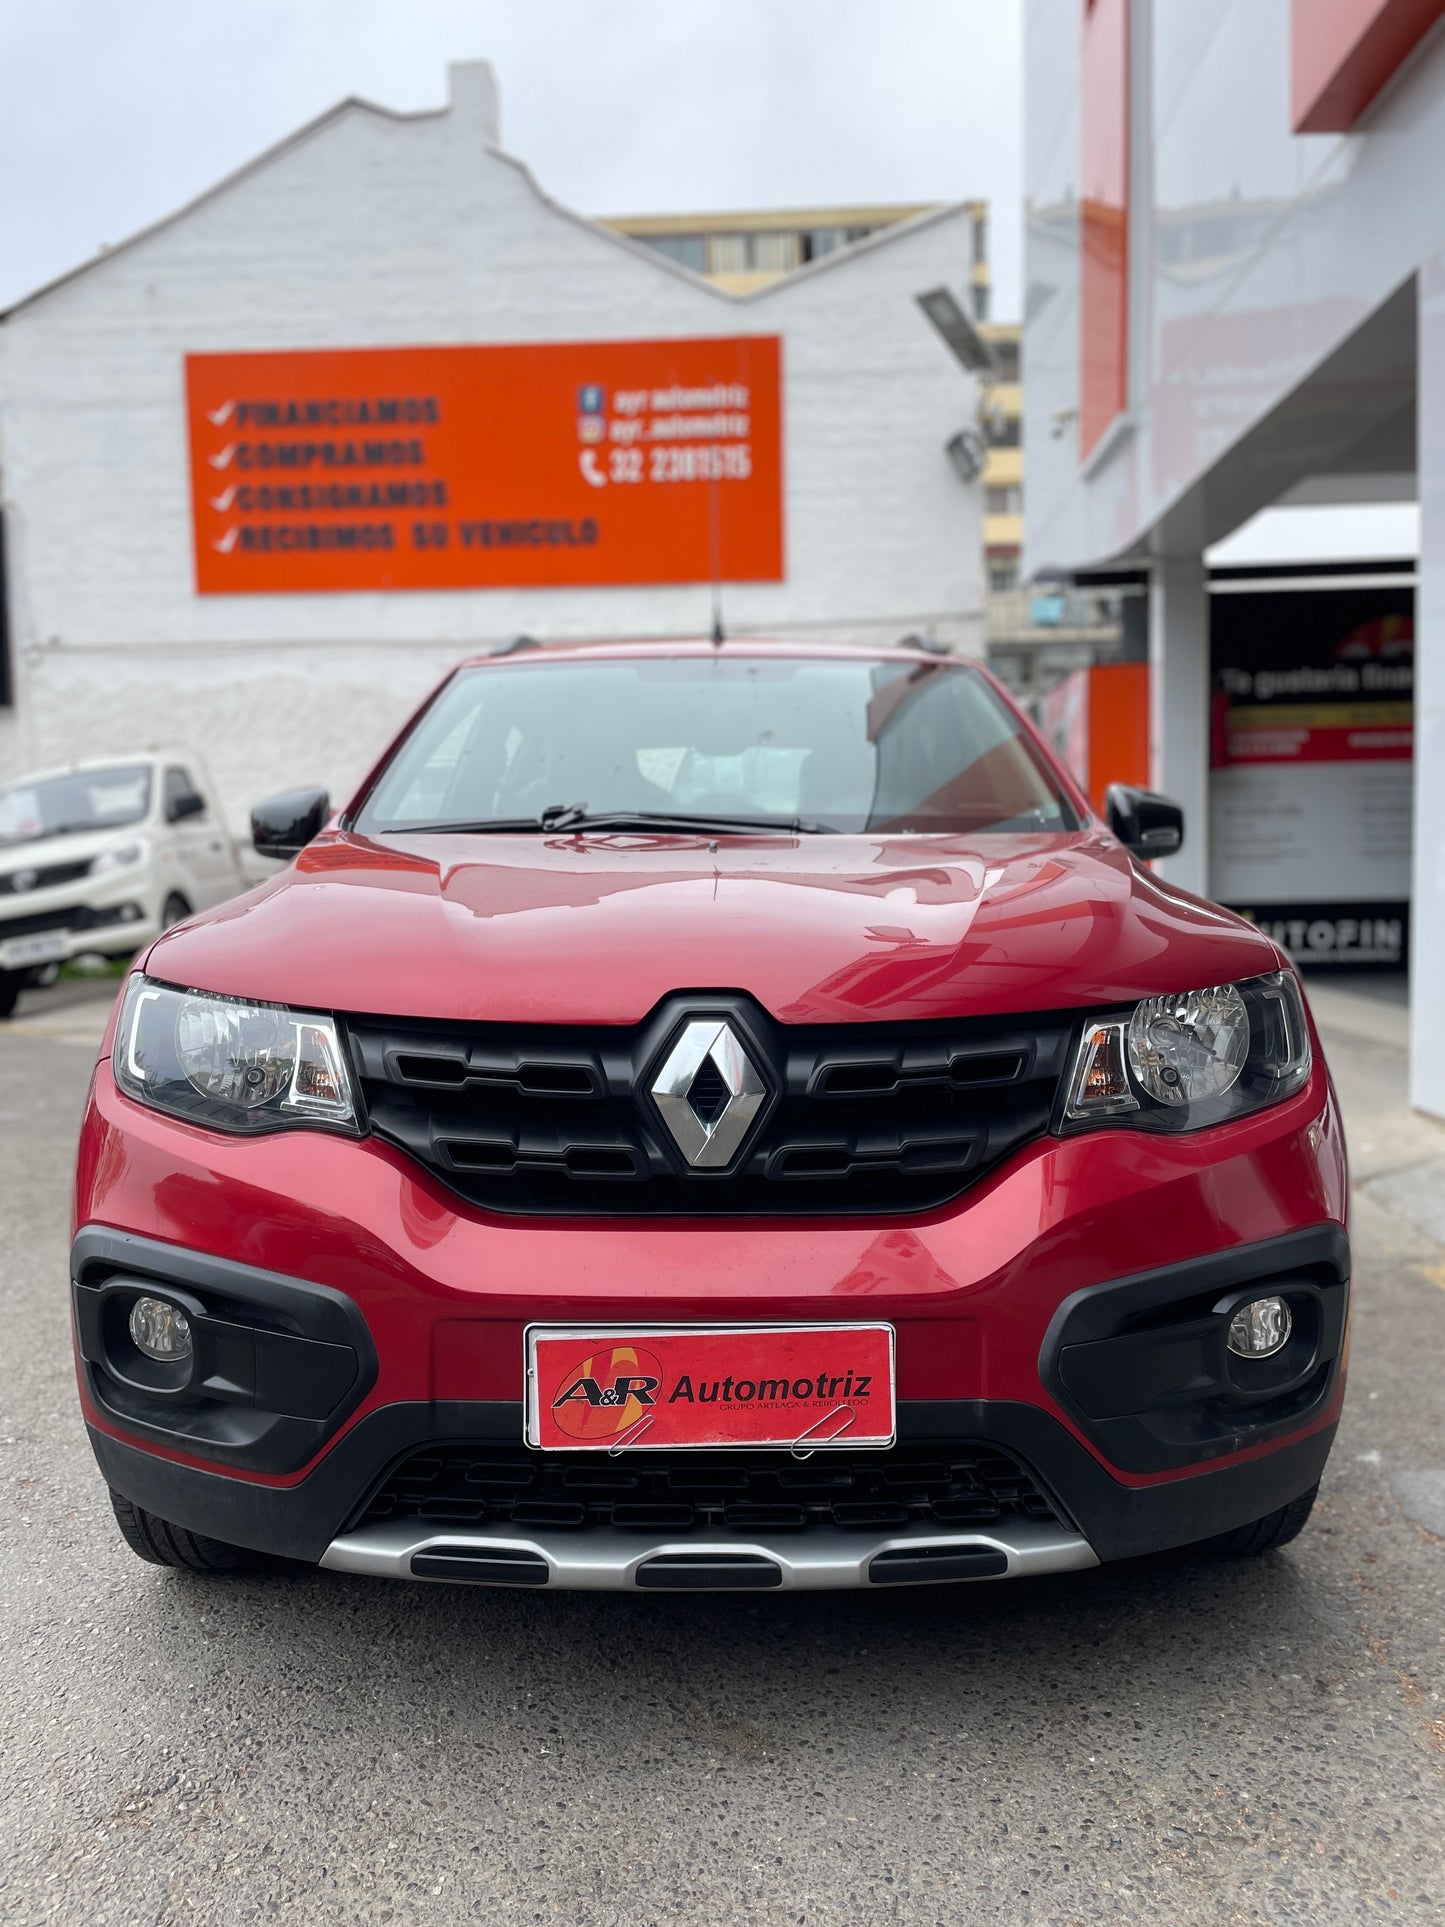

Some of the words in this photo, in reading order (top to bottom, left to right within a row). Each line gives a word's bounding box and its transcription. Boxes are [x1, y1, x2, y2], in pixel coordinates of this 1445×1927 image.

[235, 397, 441, 427] FINANCIAMOS
[236, 440, 426, 469] COMPRAMOS
[609, 447, 644, 482] 32
[237, 481, 450, 511] CONSIGNAMOS
[240, 522, 396, 553] RECIBIMOS
[411, 520, 449, 549] SU
[1260, 919, 1401, 951] UTOFIN
[667, 1370, 872, 1404] Automotriz
[719, 1403, 755, 1411] GRUPO
[757, 1401, 800, 1409] ARTEAGA
